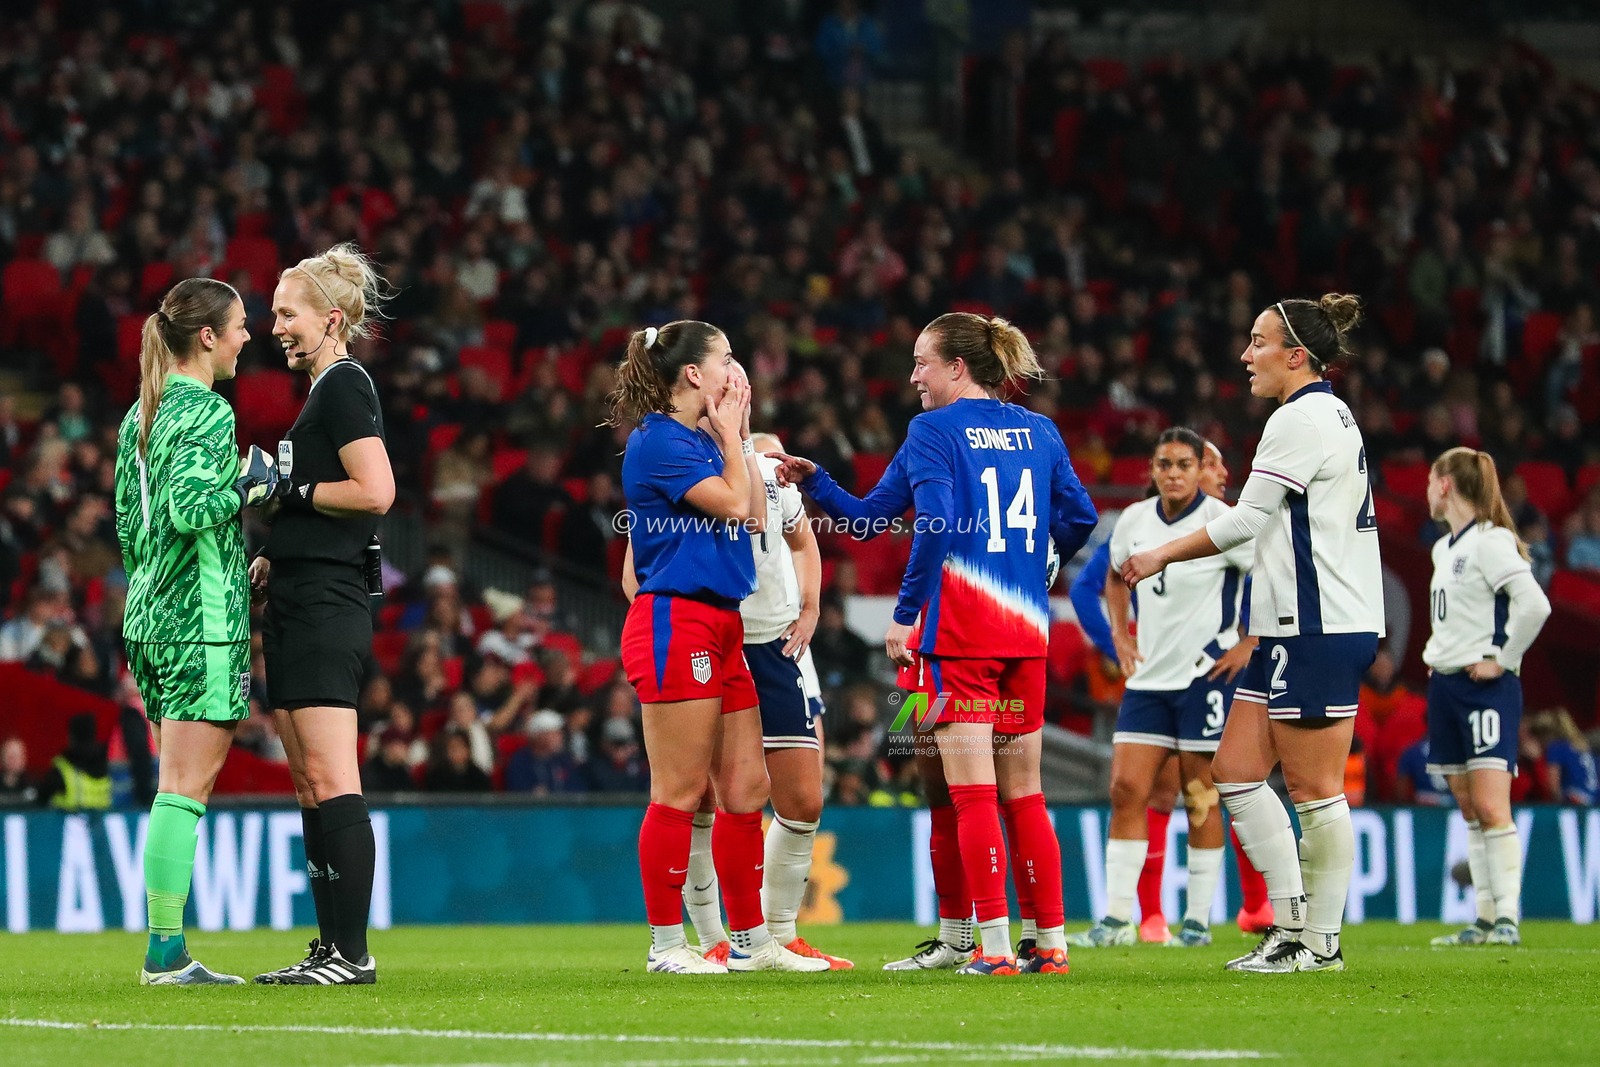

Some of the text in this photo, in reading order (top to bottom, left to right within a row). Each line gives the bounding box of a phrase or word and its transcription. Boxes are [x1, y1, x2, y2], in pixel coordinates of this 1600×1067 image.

[965, 427, 1033, 450] SONNETT
[980, 467, 1037, 553] 14
[1432, 588, 1447, 622] 10
[693, 657, 709, 668] USA
[1271, 645, 1288, 689] 2
[1206, 690, 1225, 728] 3
[1468, 709, 1500, 745] 10
[990, 847, 998, 873] USA
[1027, 860, 1036, 883] USA
[1291, 896, 1300, 921] ESIGN
